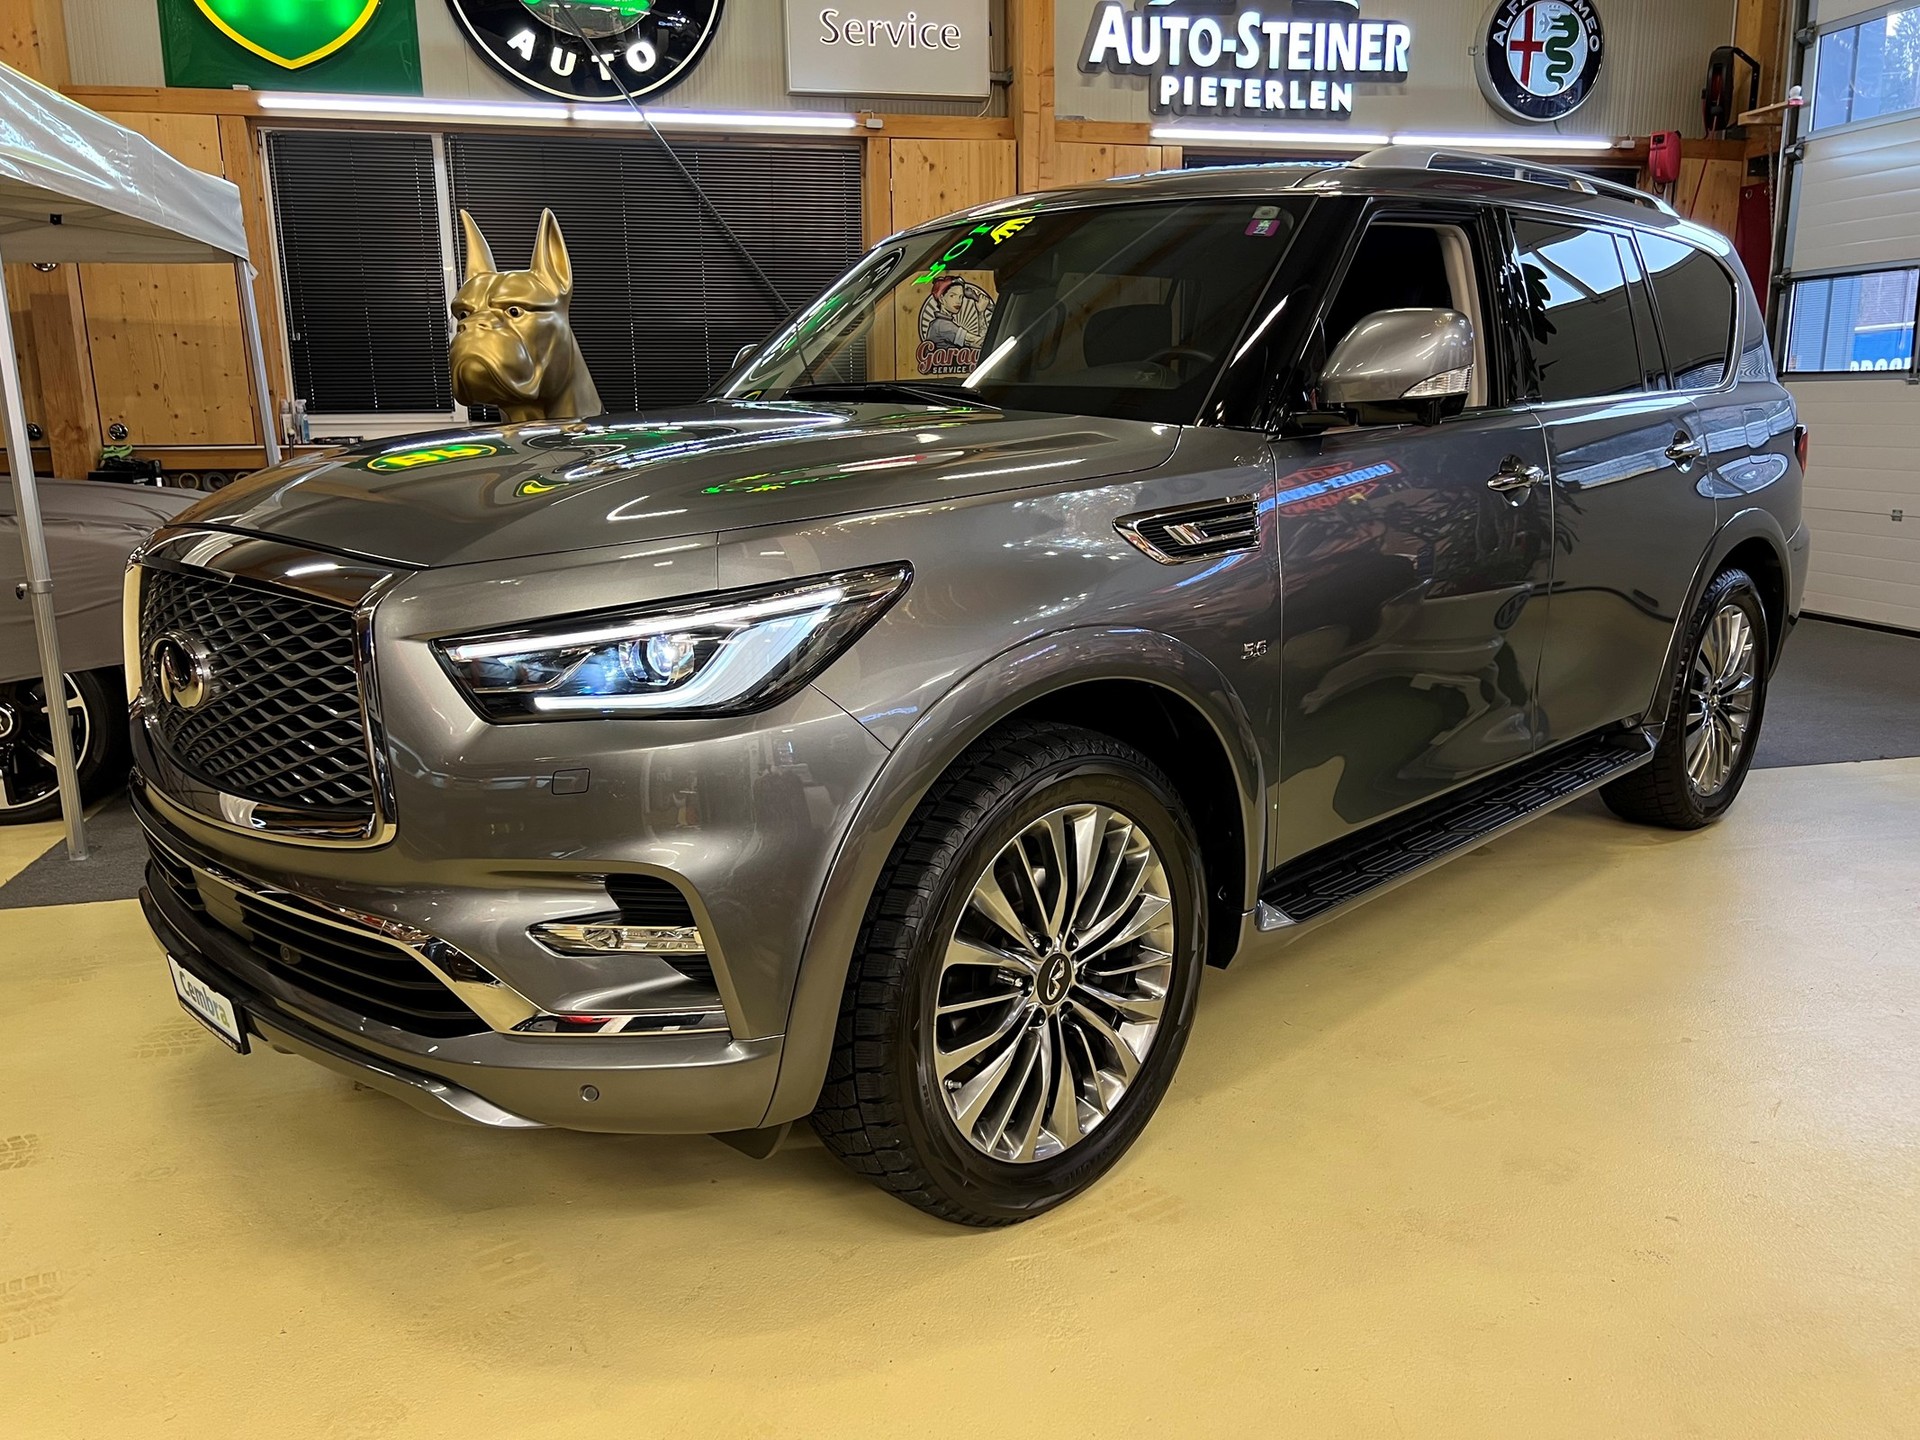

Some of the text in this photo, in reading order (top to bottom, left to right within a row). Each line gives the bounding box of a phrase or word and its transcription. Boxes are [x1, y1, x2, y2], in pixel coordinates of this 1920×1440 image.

[819, 8, 962, 50] Service
[1088, 5, 1411, 73] AUTO-STEINER
[1492, 0, 1527, 47] ALF
[506, 28, 657, 82] AUTO
[1160, 75, 1352, 112] PIETERLEN
[932, 365, 967, 374] SERVICE
[179, 970, 231, 1028] Cembra
